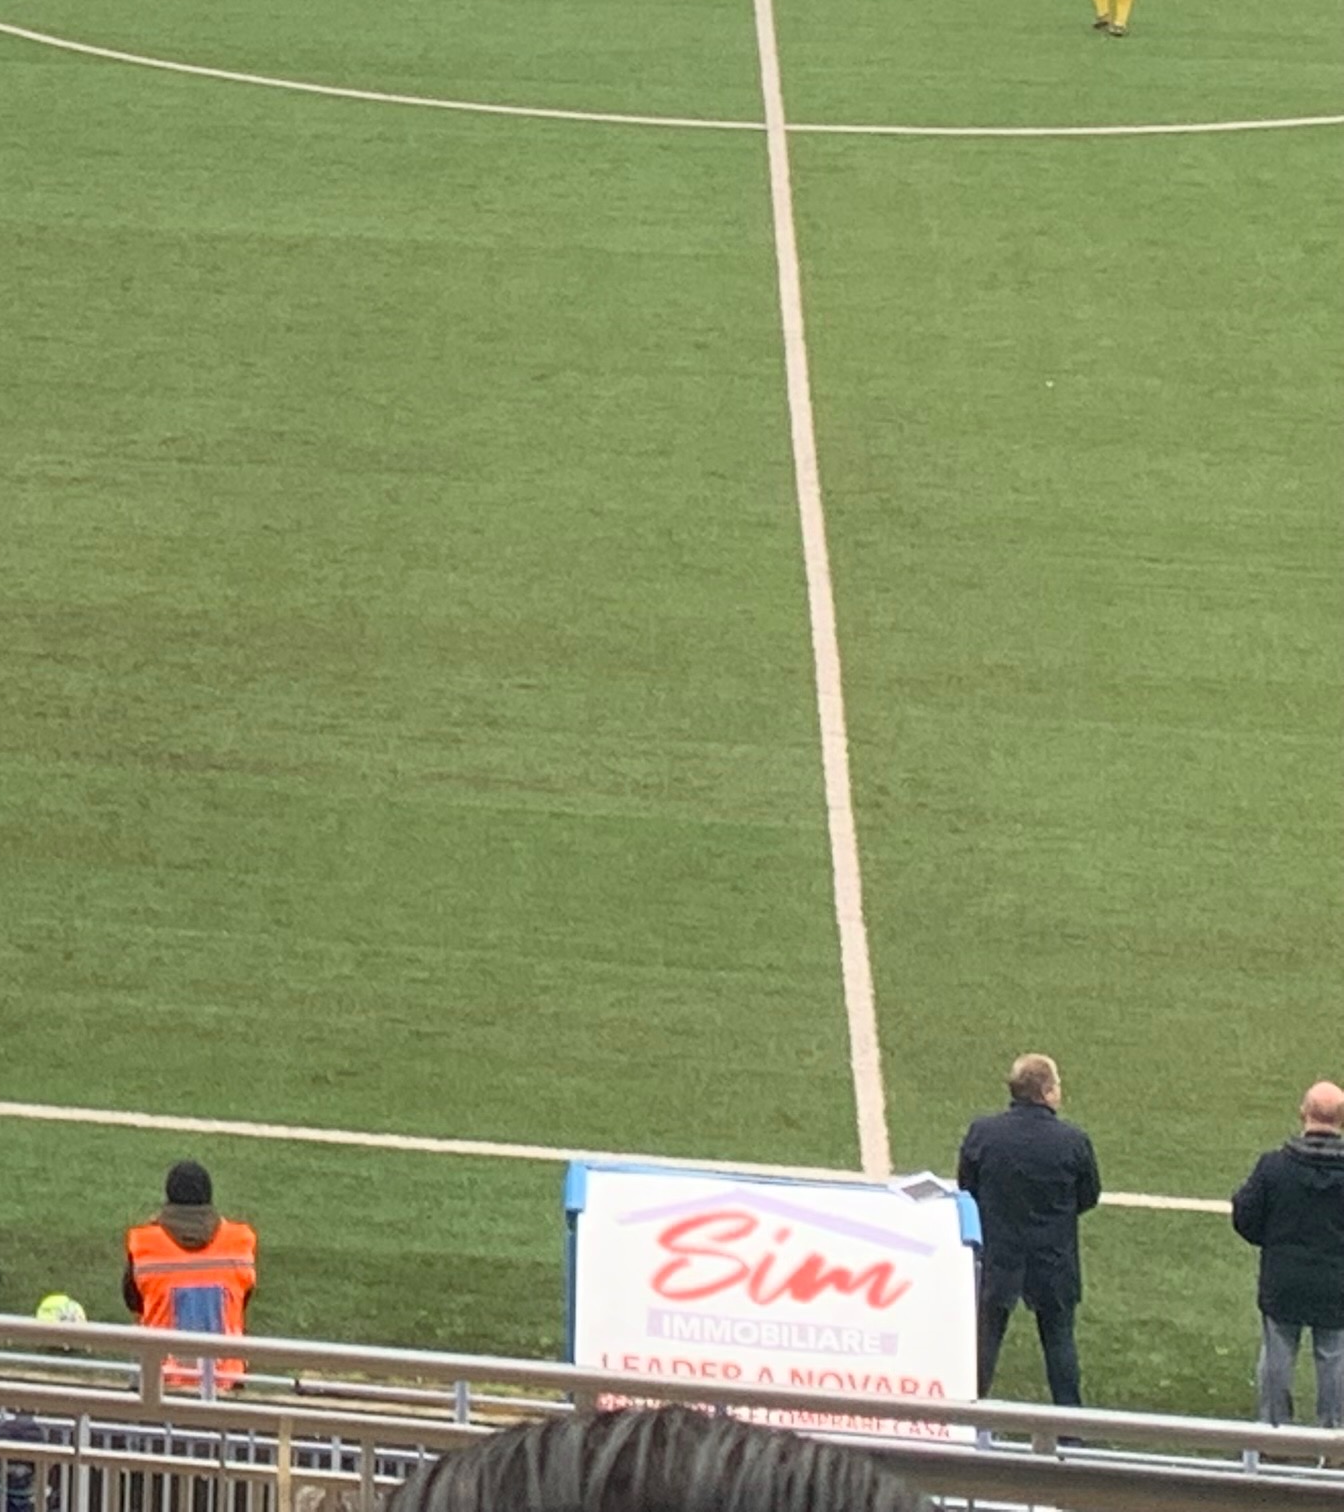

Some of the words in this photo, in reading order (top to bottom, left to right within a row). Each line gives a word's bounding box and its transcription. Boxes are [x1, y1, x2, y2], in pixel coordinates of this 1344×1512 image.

[650, 1209, 913, 1311] Sim
[660, 1312, 883, 1355] IMMOBILIARE
[789, 1367, 947, 1399] NOVARA
